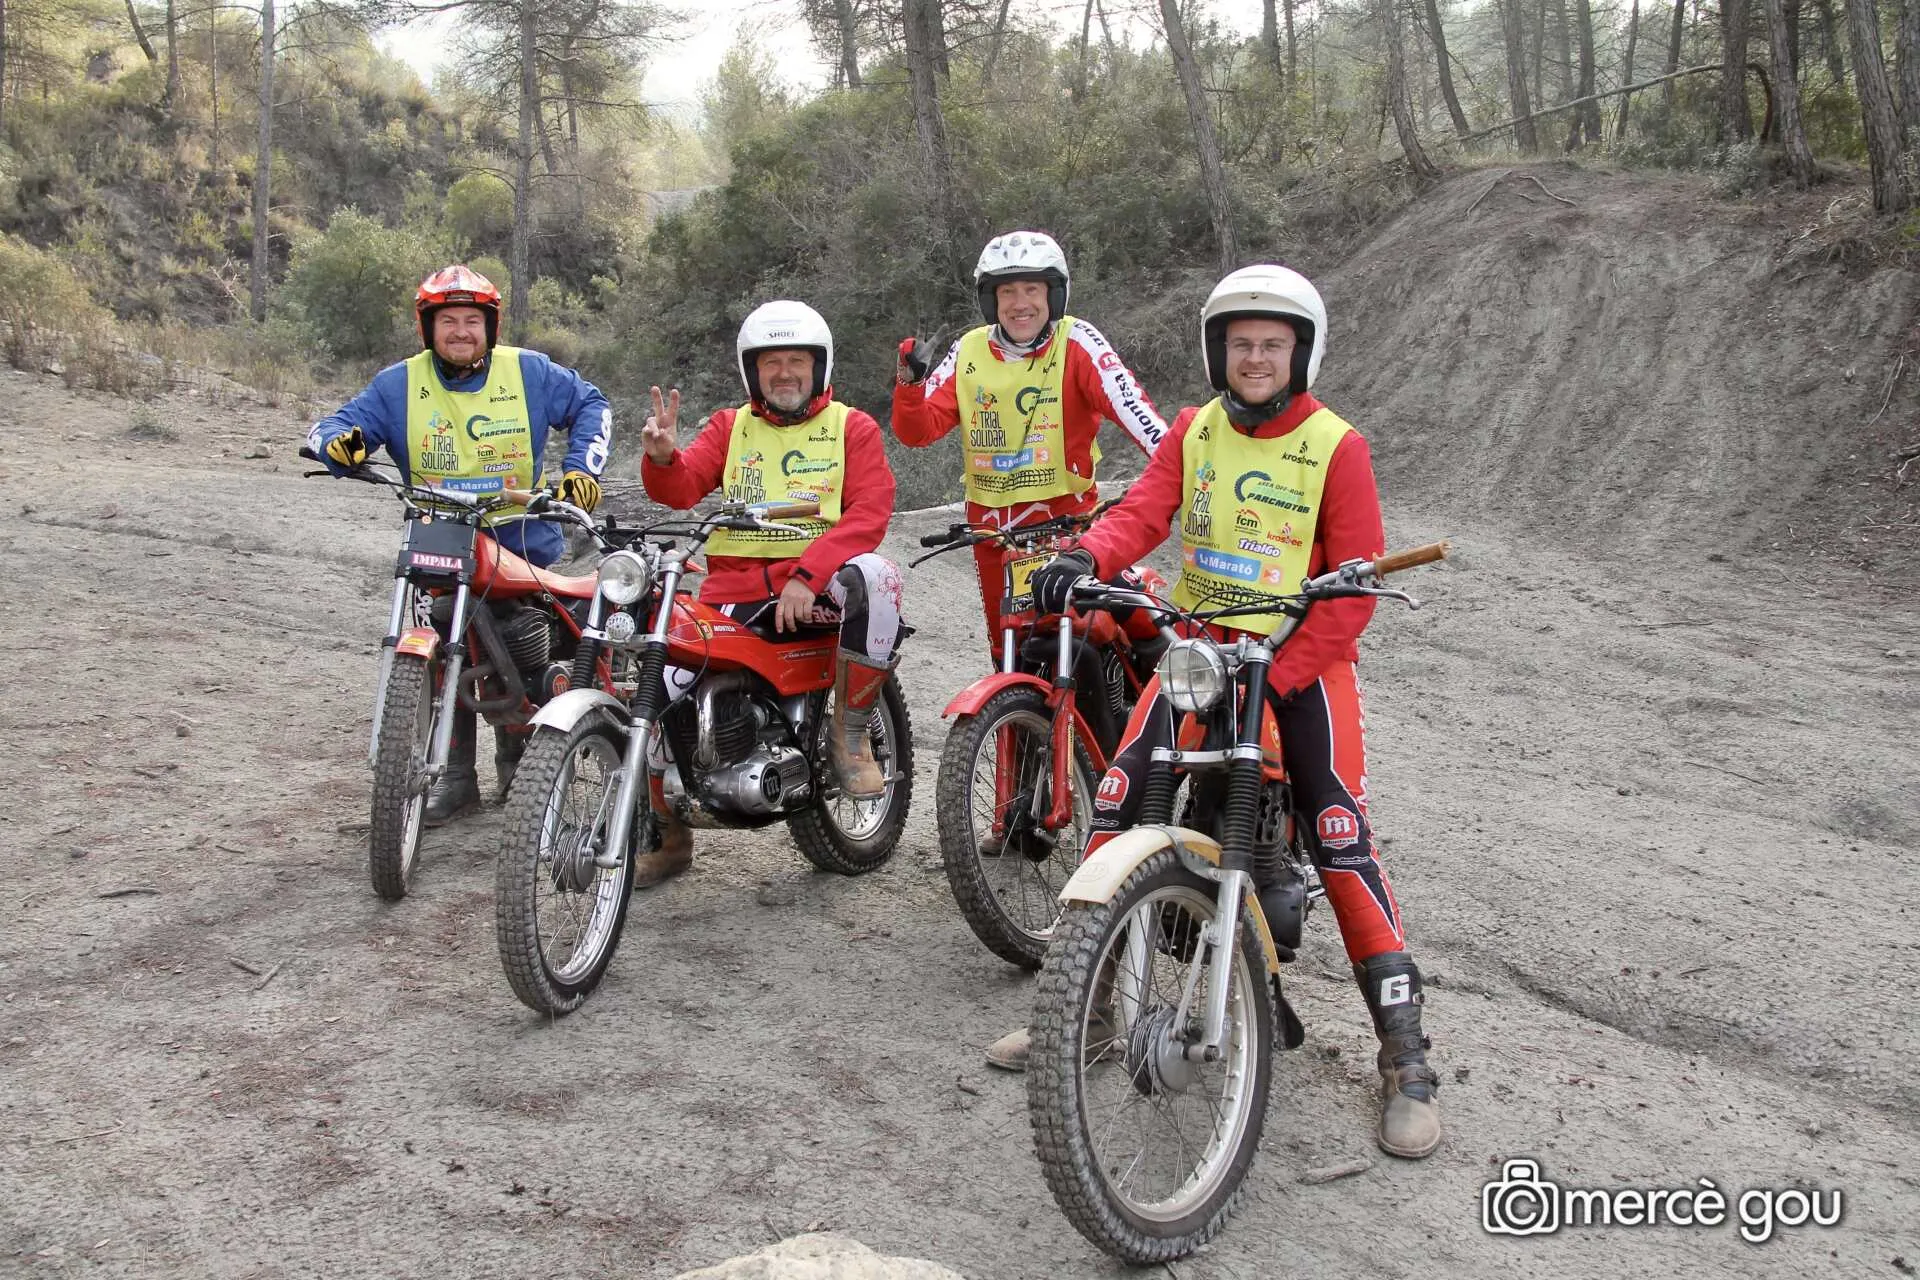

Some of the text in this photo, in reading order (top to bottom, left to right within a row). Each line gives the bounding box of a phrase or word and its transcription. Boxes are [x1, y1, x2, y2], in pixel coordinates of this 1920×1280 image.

[1114, 373, 1163, 446] Montesa
[1282, 452, 1318, 468] krosbee
[462, 480, 499, 490] Marató
[1247, 492, 1311, 514] PARCMOTOR
[1235, 514, 1258, 528] fcm
[1238, 537, 1281, 557] TrialGo
[1267, 531, 1303, 547] krosbee
[412, 553, 463, 570] IMPALA
[1208, 556, 1254, 576] Marató
[1380, 973, 1410, 1006] G
